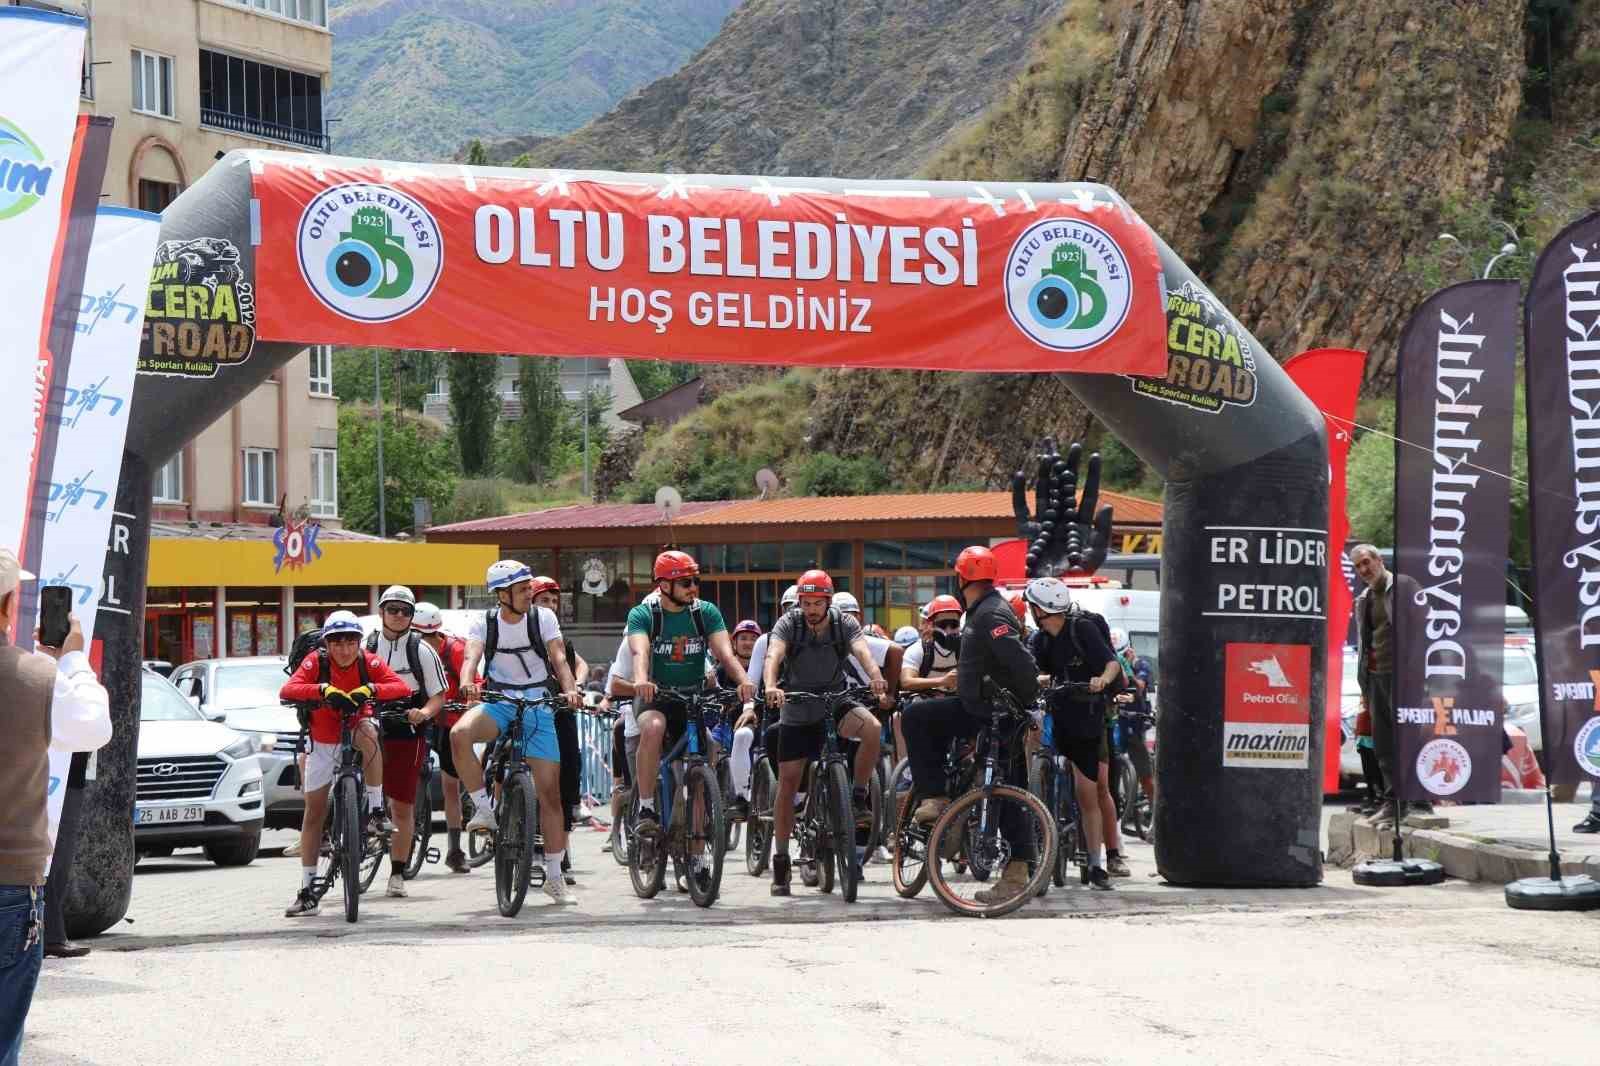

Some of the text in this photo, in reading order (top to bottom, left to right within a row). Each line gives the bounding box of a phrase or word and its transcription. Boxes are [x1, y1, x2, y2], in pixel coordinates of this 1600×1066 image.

[309, 199, 339, 240] OLTU
[357, 215, 384, 227] 1923
[474, 204, 979, 287] OLTU BELEDİYESİ
[1015, 238, 1041, 278] OLTU
[1056, 251, 1080, 262] 1923
[589, 286, 872, 334] HOŞ GELDİNİZ
[1168, 317, 1246, 369] CERA
[1211, 532, 1326, 567] ER LİDER
[1218, 584, 1322, 612] PETROL
[1243, 693, 1275, 704] Petrol
[1226, 730, 1308, 751] maxima
[140, 807, 203, 822] 25 AAB 291
